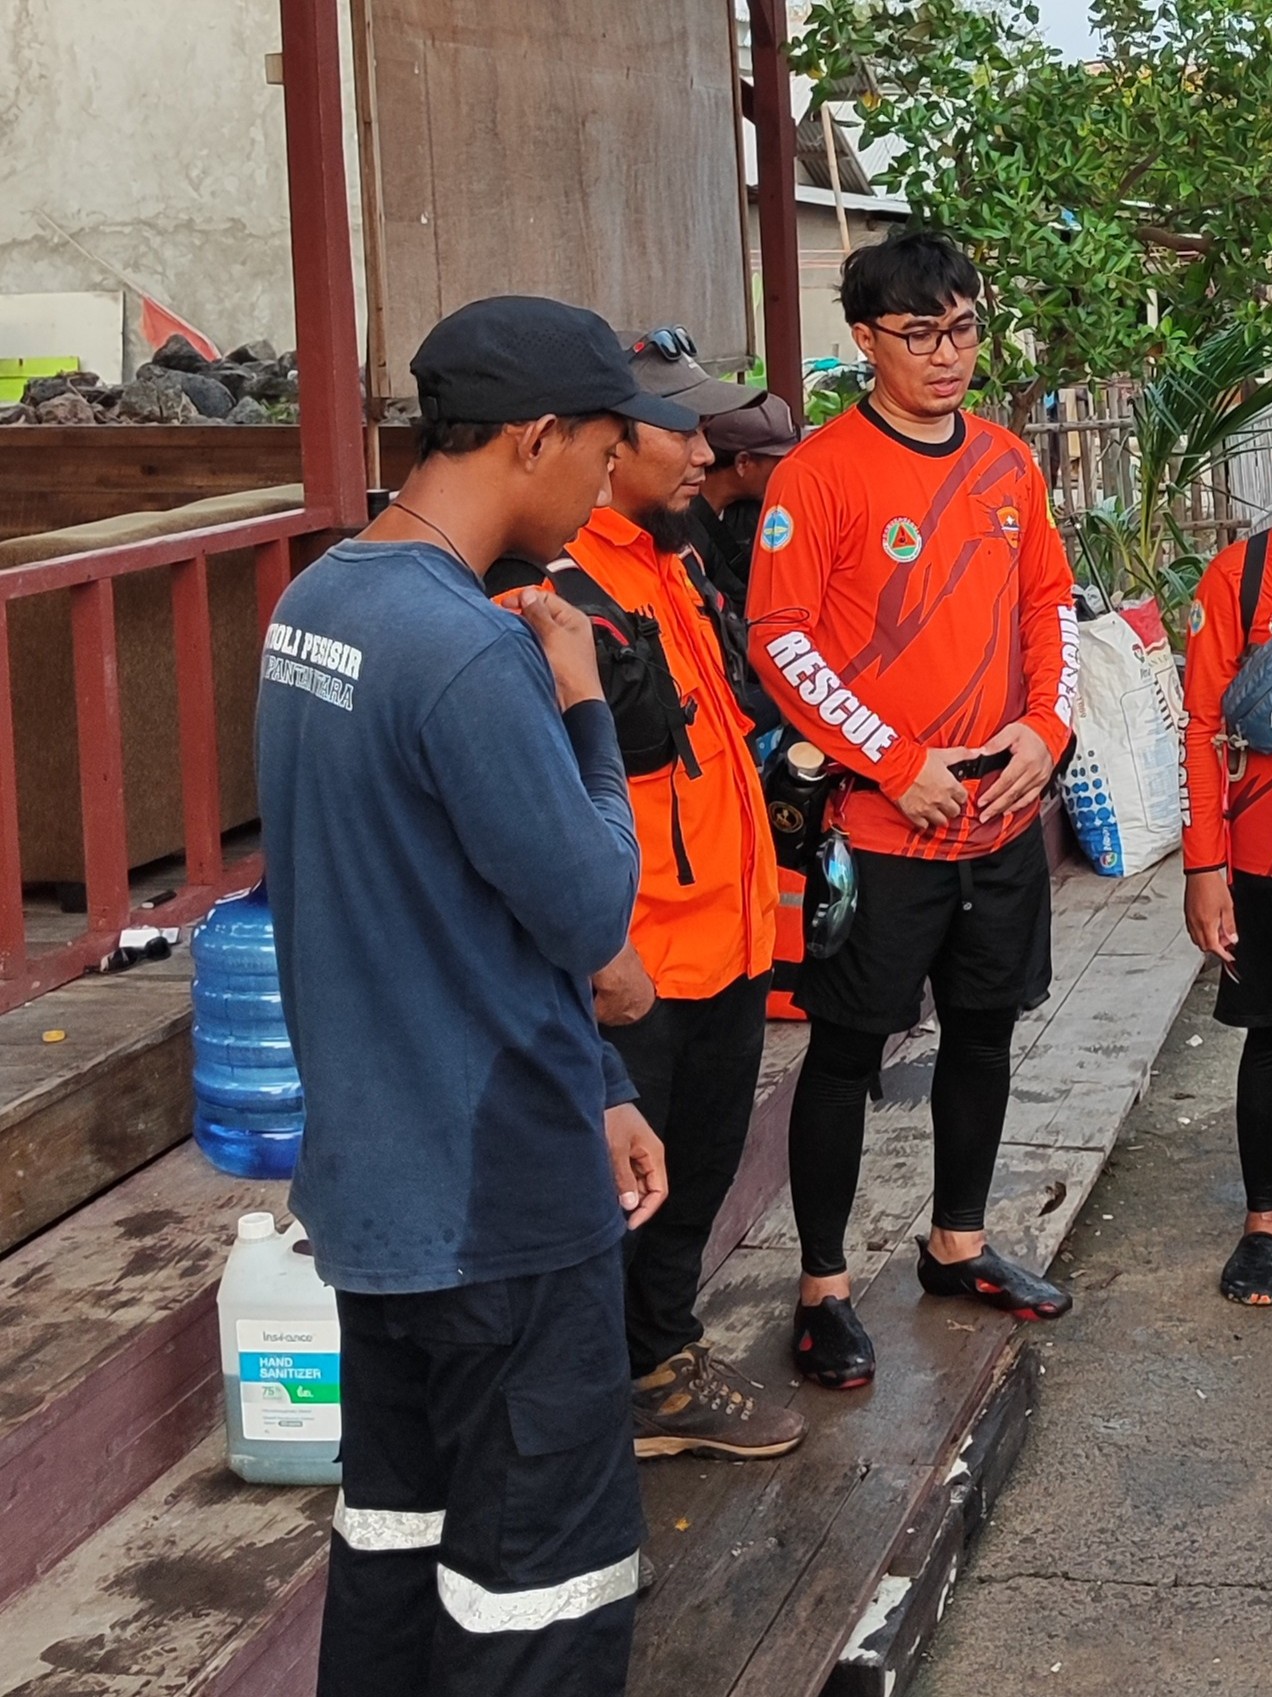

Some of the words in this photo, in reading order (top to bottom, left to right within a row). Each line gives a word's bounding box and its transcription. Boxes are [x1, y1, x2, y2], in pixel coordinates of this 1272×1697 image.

[765, 630, 900, 764] RESCUE
[259, 1357, 293, 1368] HAND
[259, 1368, 322, 1380] SANITIZER
